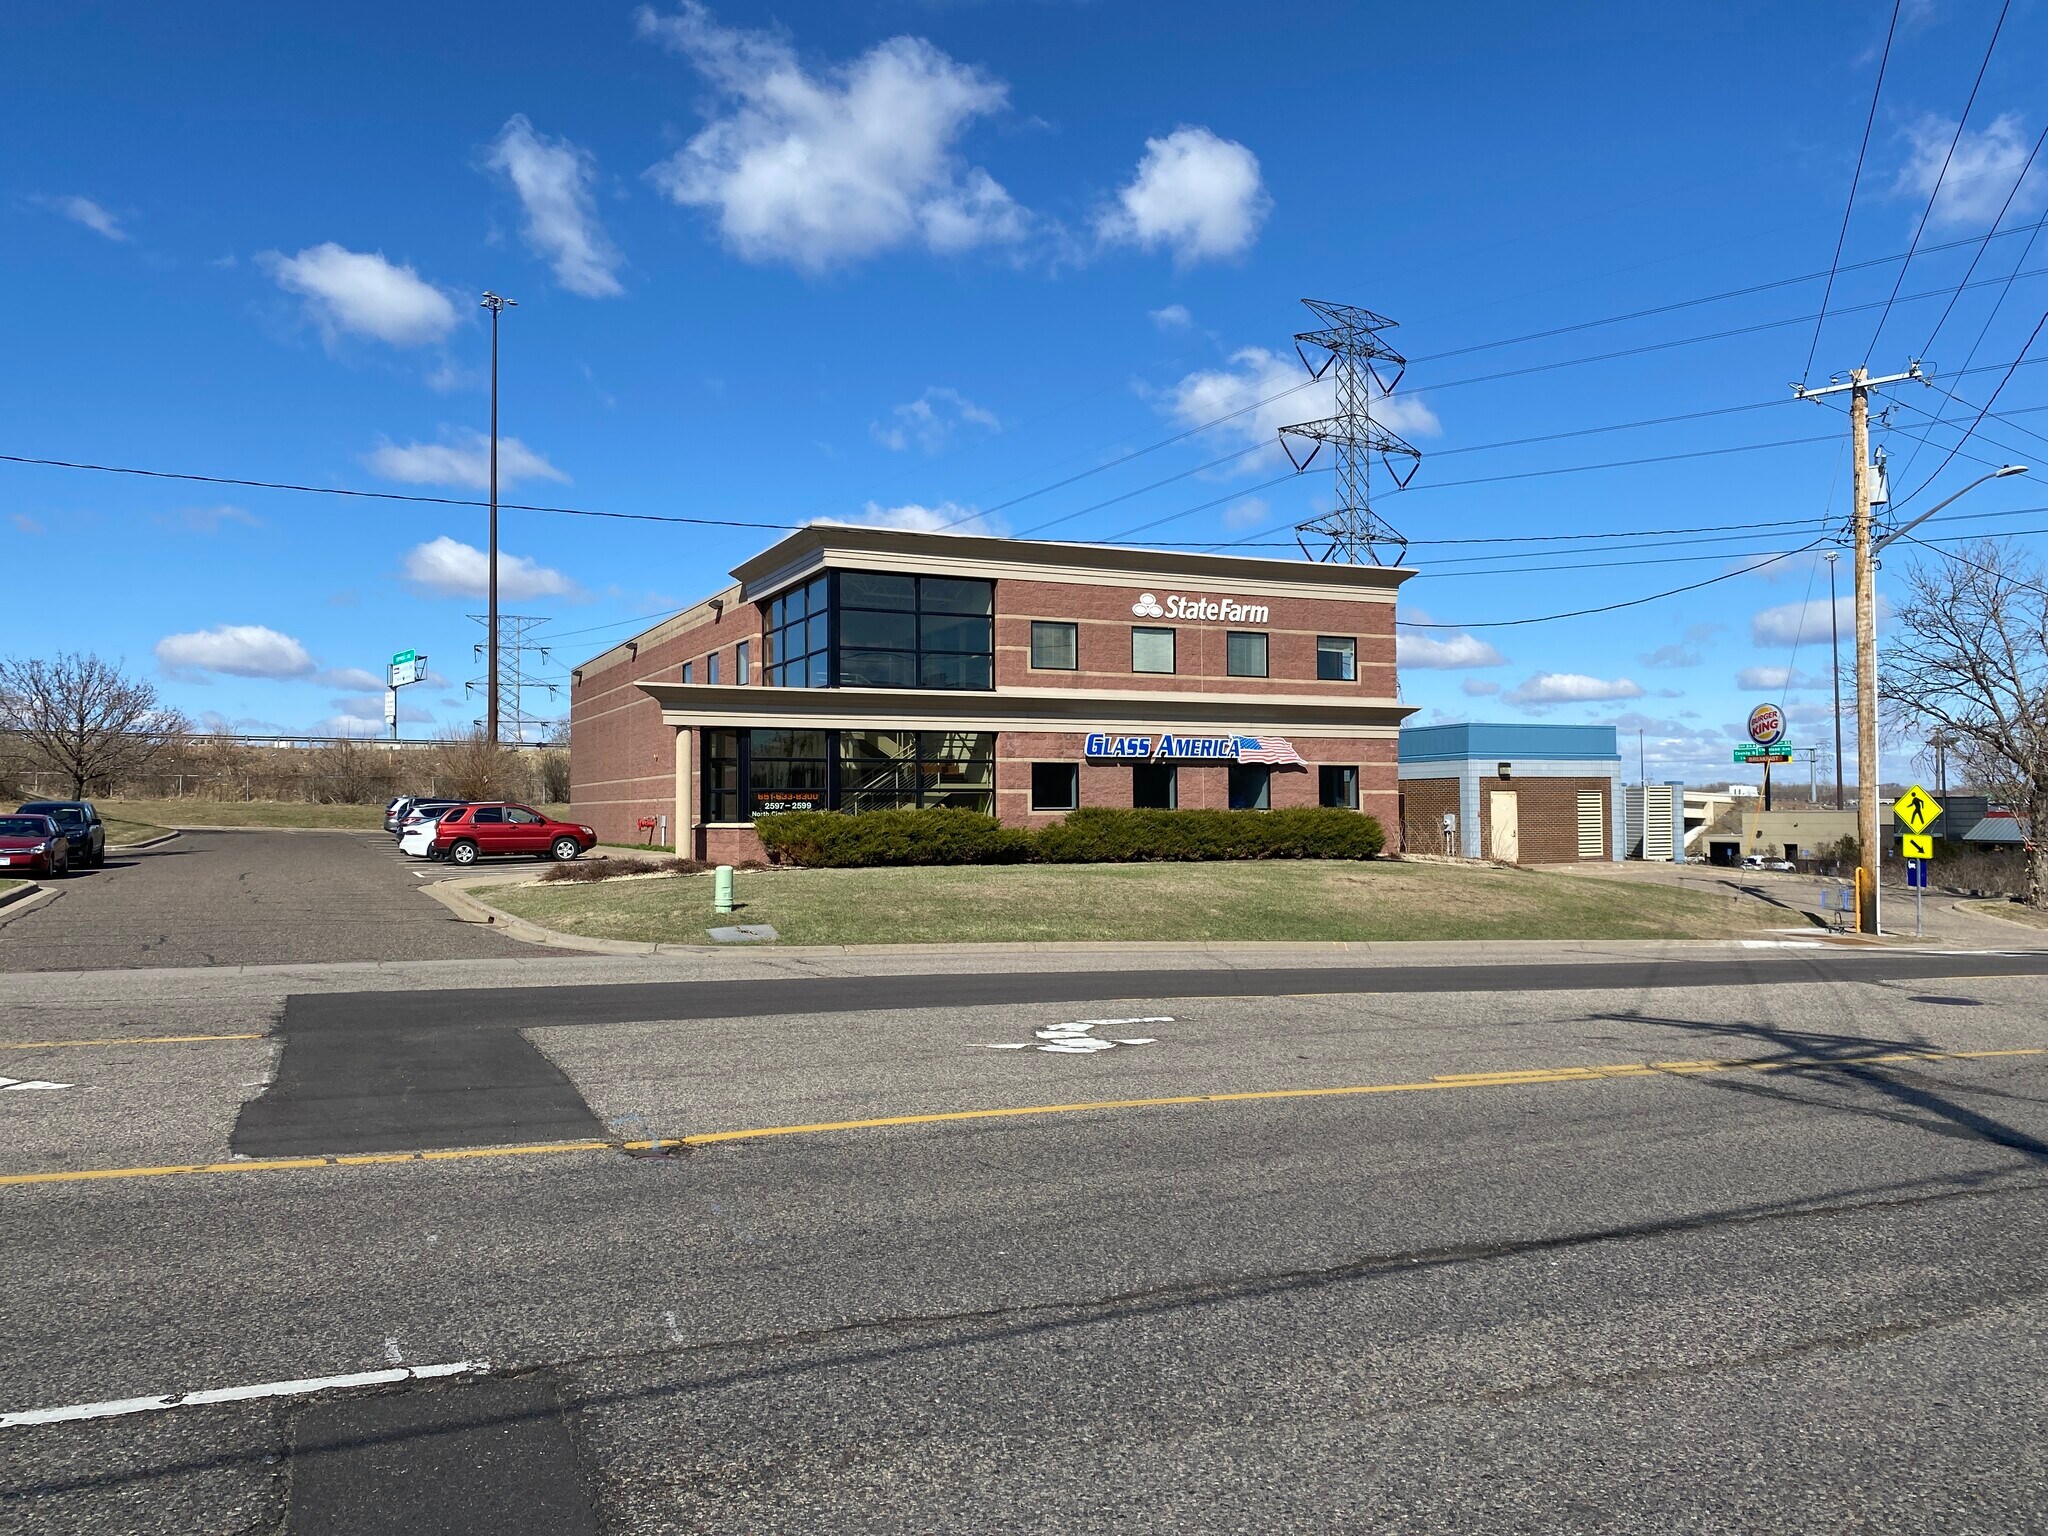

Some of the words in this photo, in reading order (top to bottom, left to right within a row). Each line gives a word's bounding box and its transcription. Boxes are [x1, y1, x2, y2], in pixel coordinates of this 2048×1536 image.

[1751, 711, 1778, 725] BURGER
[1752, 719, 1779, 736] KING
[1086, 733, 1150, 756] GLASS
[1156, 734, 1240, 757] AMERICA
